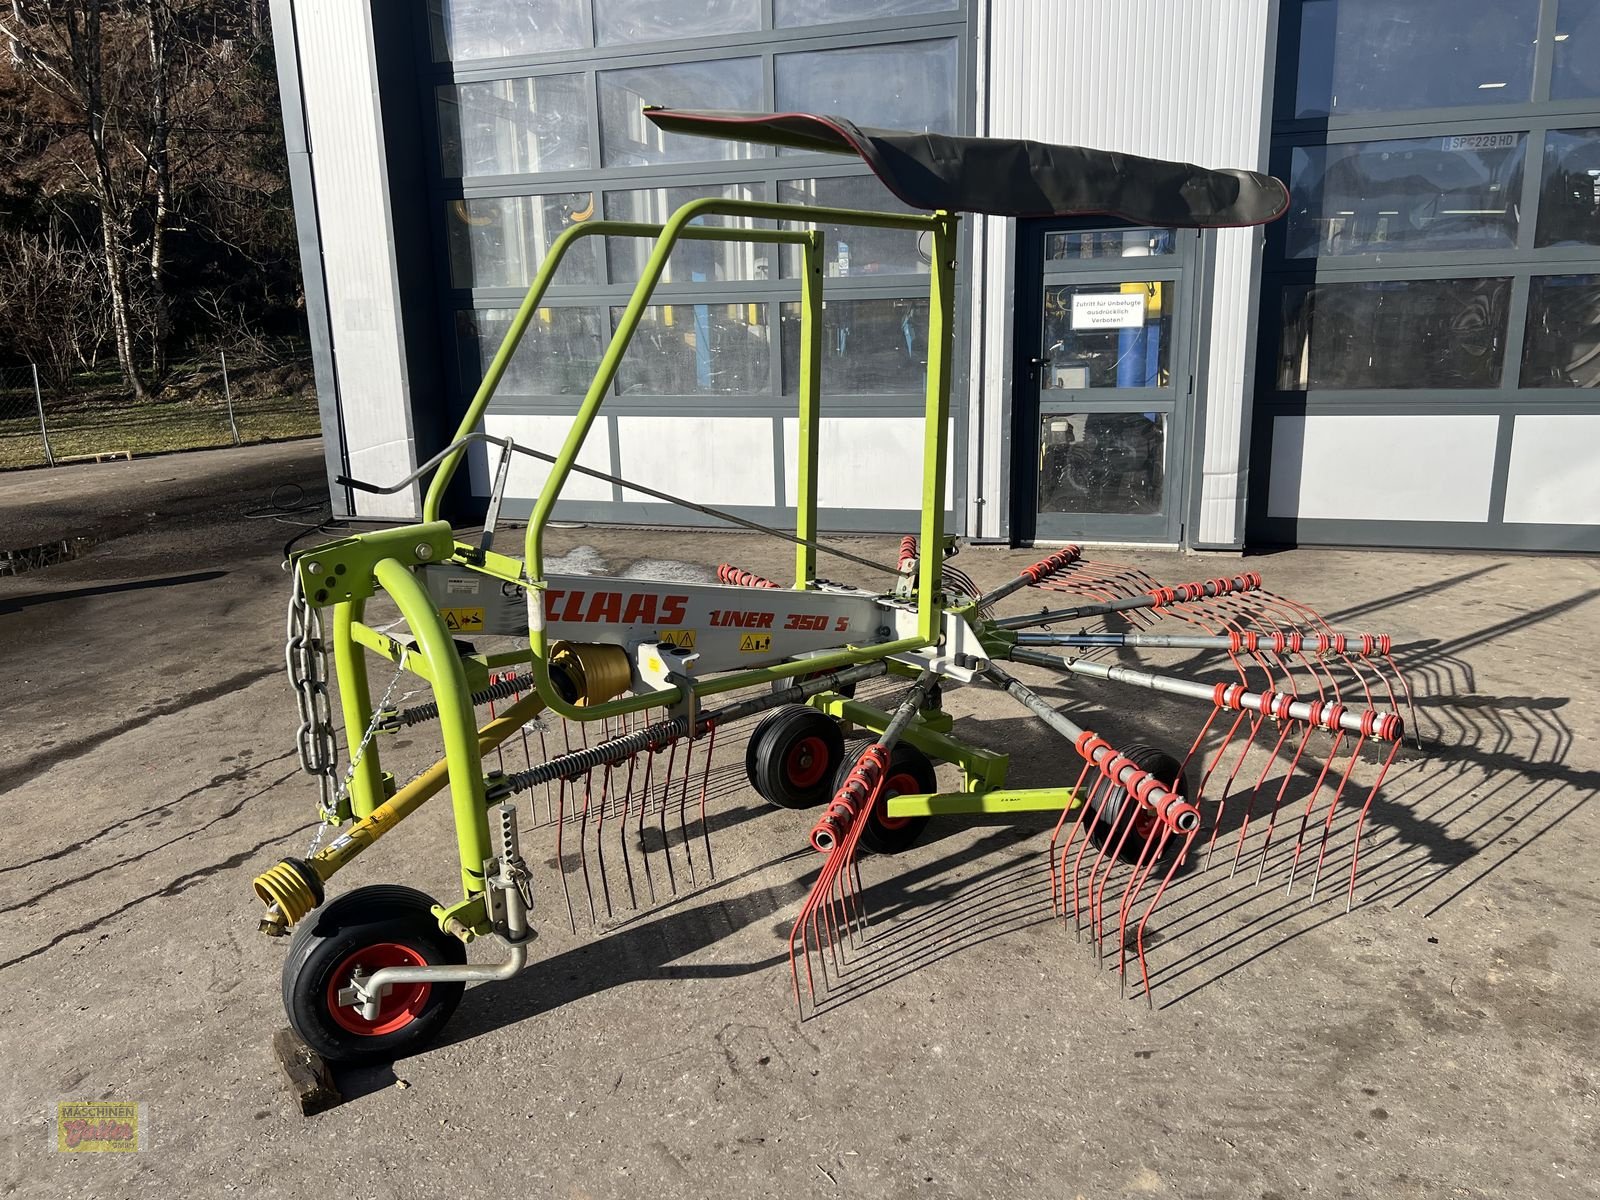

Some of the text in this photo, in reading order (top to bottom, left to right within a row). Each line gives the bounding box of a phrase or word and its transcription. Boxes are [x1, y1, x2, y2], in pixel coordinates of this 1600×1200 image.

[1107, 299, 1141, 308] Unbefugte
[1086, 308, 1129, 316] ausdrücklich
[545, 590, 689, 625] CLAAS
[708, 610, 849, 632] LINER 350 S
